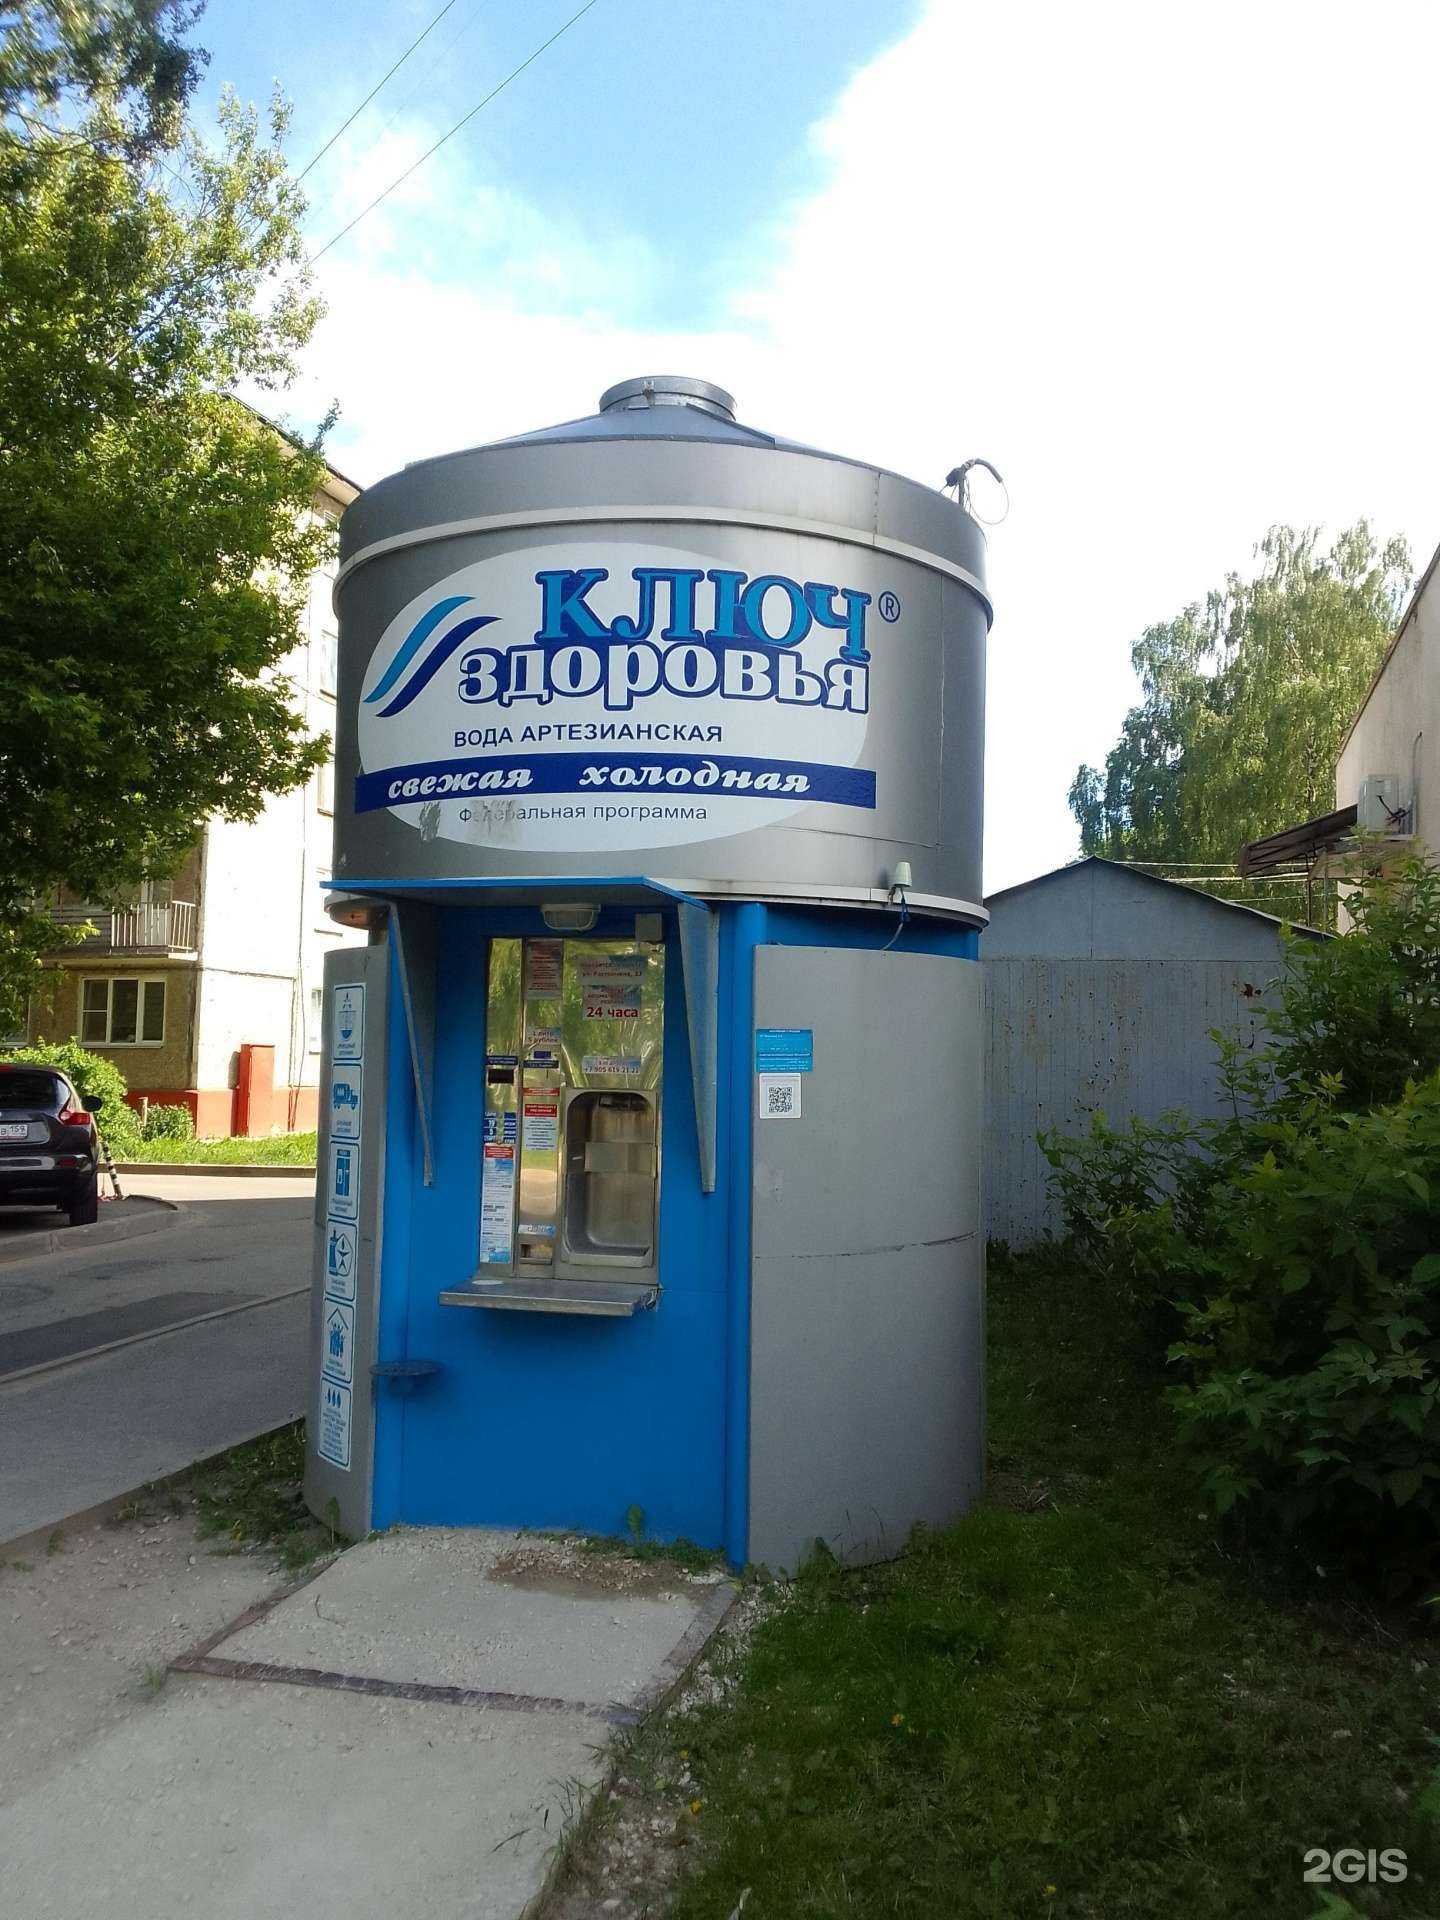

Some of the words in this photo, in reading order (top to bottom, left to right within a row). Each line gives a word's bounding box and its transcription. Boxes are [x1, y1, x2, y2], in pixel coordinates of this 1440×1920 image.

[535, 567, 872, 663] КЛЮЧ
[457, 637, 870, 714] здоровья
[453, 729, 514, 748] ВОДА
[520, 722, 723, 743] АРТЕЗИАНСКАЯ
[387, 766, 533, 799] свежая
[578, 759, 811, 794] холодная
[593, 806, 707, 822] программа
[587, 1006, 602, 1018] 24
[607, 1007, 639, 1018] часа
